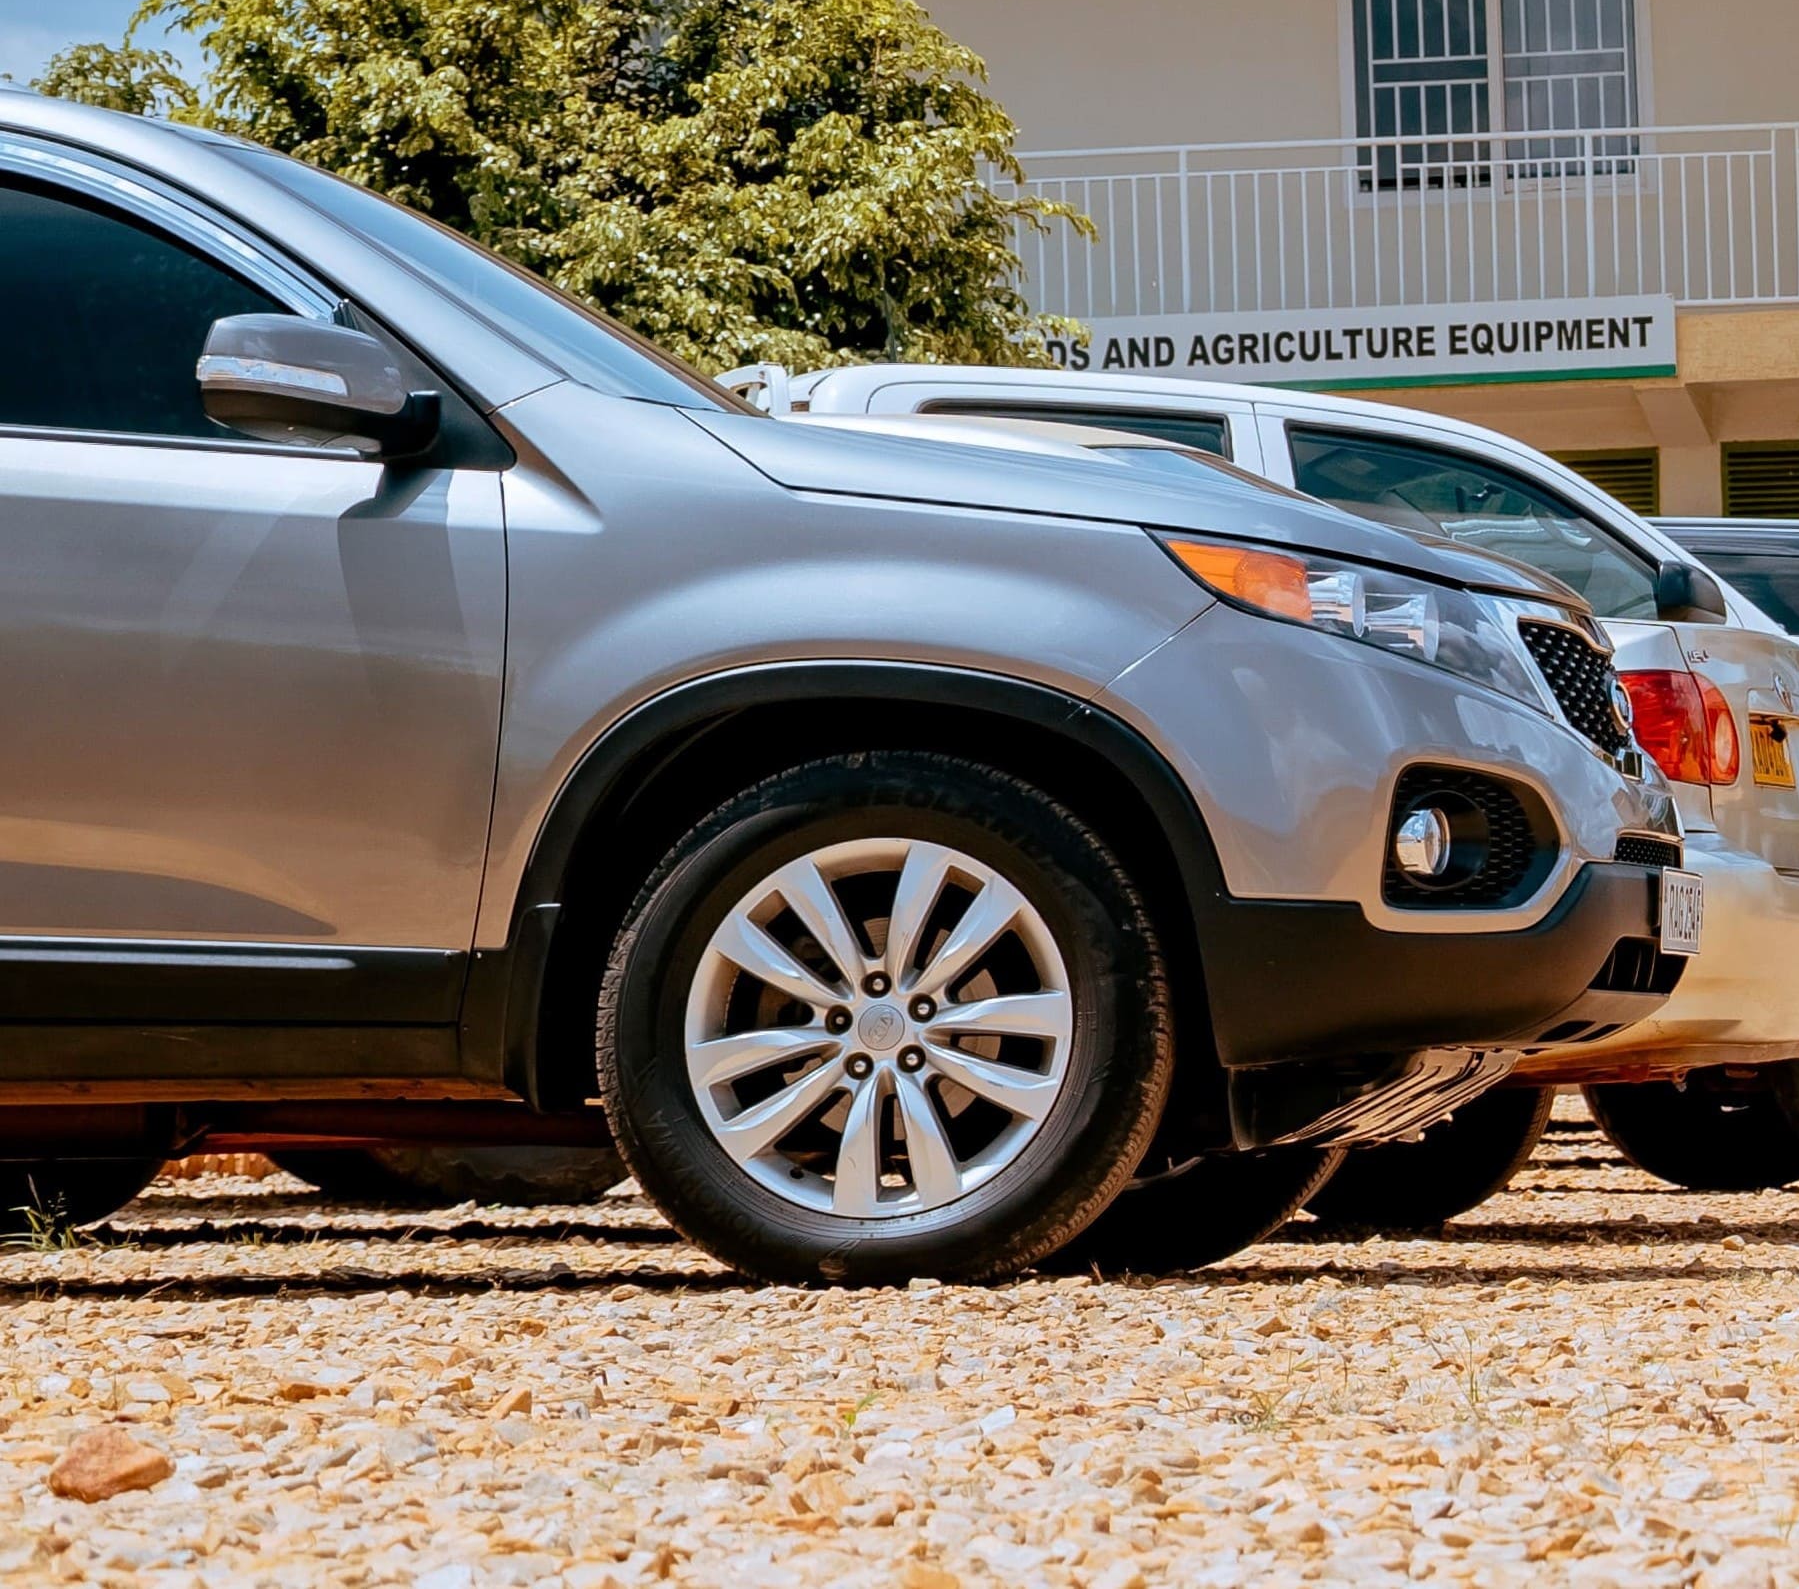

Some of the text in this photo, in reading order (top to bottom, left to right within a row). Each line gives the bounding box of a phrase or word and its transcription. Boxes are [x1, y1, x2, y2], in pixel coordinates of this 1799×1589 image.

[1102, 336, 1175, 369] AND
[1187, 325, 1435, 366] AGRICULTURE
[1448, 315, 1653, 358] EQUIPMENT
